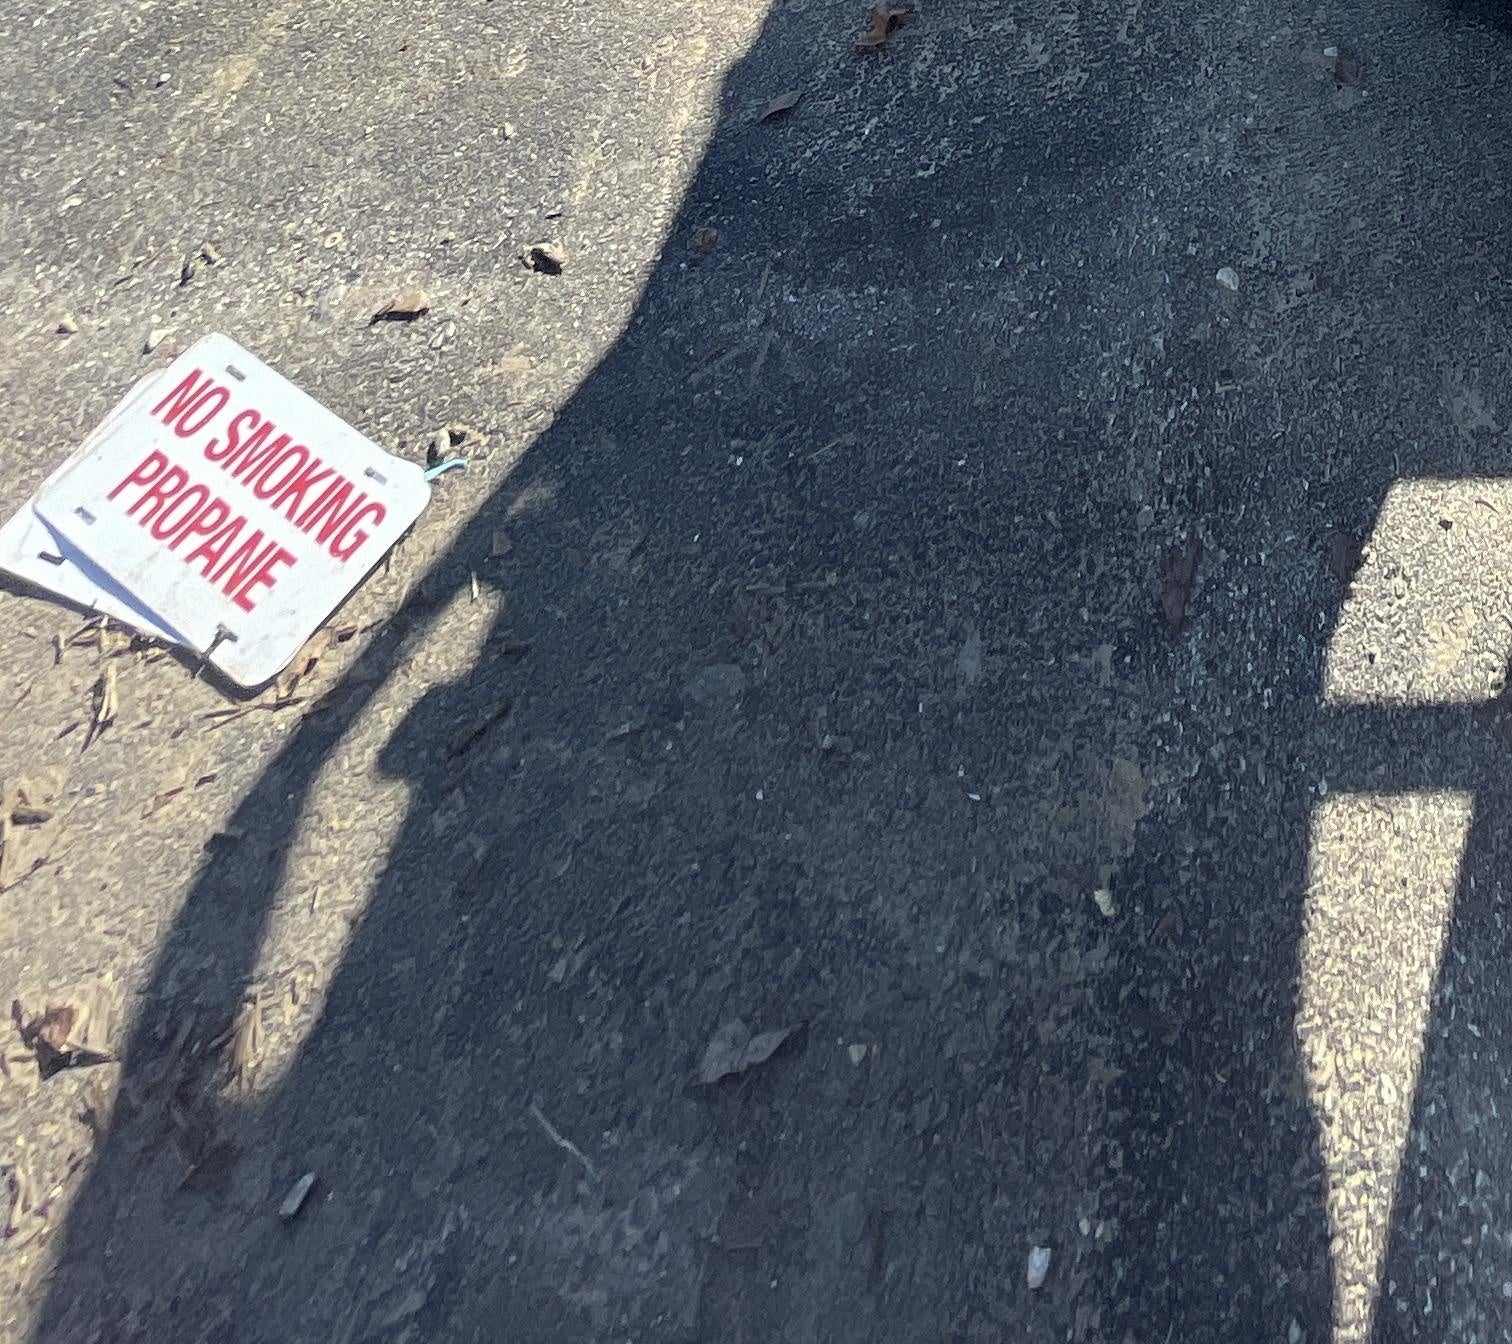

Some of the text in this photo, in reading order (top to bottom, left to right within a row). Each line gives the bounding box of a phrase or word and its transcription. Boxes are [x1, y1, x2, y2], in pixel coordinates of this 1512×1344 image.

[107, 449, 299, 613] PROPANE
[150, 368, 388, 563] NO SMOKING
